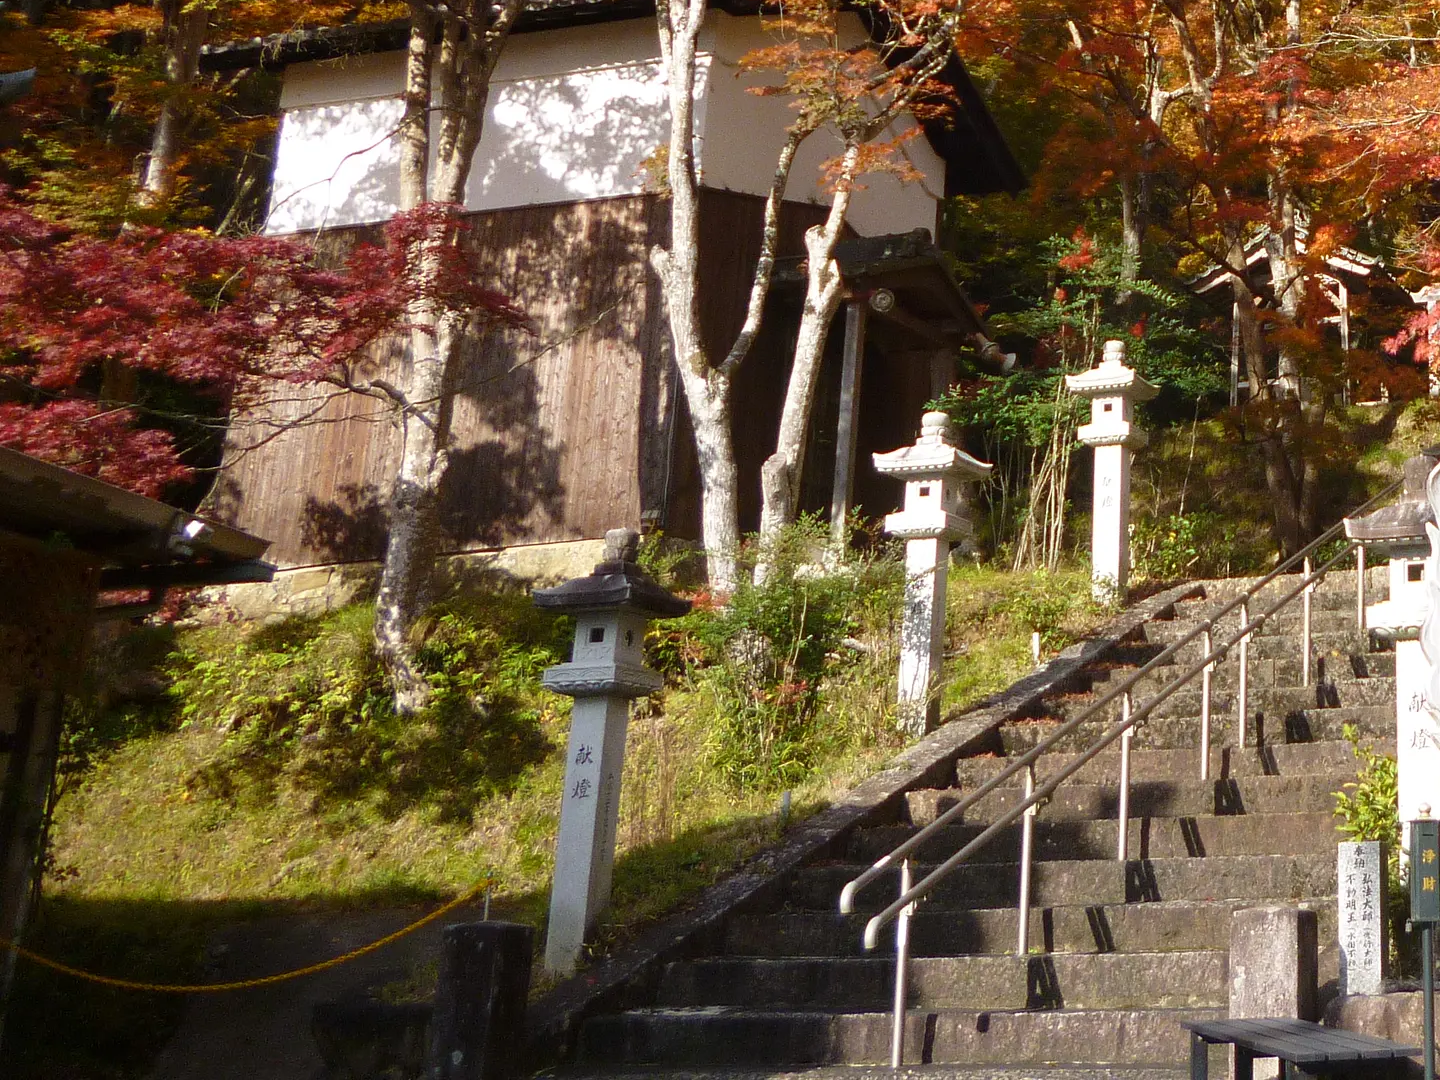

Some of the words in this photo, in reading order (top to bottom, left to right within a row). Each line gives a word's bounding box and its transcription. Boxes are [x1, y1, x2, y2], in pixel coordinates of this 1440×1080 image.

[571, 743, 594, 799] 献燈
[1354, 844, 1366, 869] 奉納
[1345, 873, 1357, 923] 不動明王
[1361, 873, 1374, 924] 弘法大師
